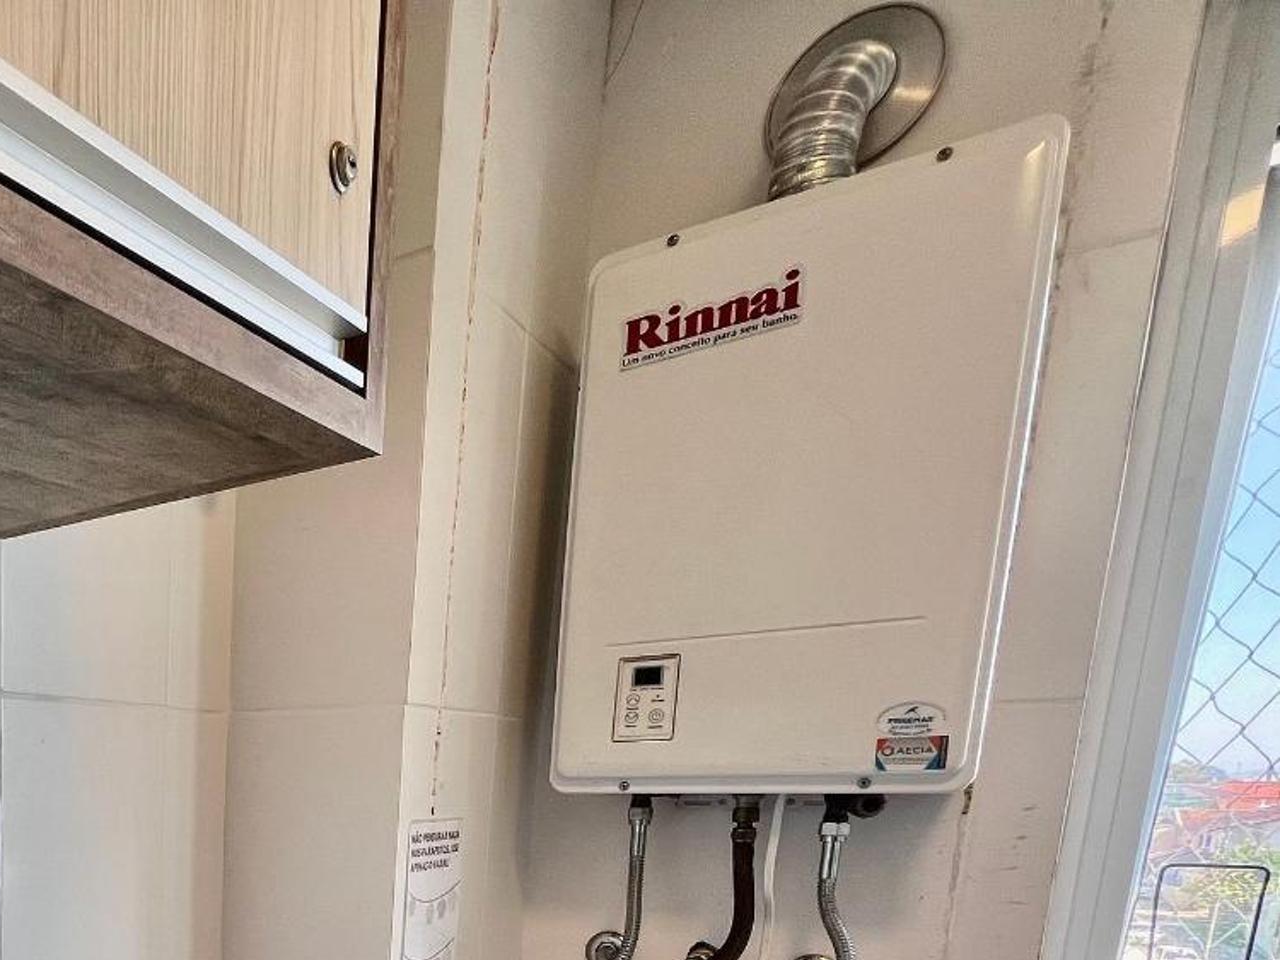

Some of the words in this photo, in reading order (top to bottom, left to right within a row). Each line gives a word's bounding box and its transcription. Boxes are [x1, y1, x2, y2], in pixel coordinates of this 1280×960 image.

[622, 268, 801, 357] Rinnai
[713, 329, 737, 345] para
[739, 323, 759, 334] seu
